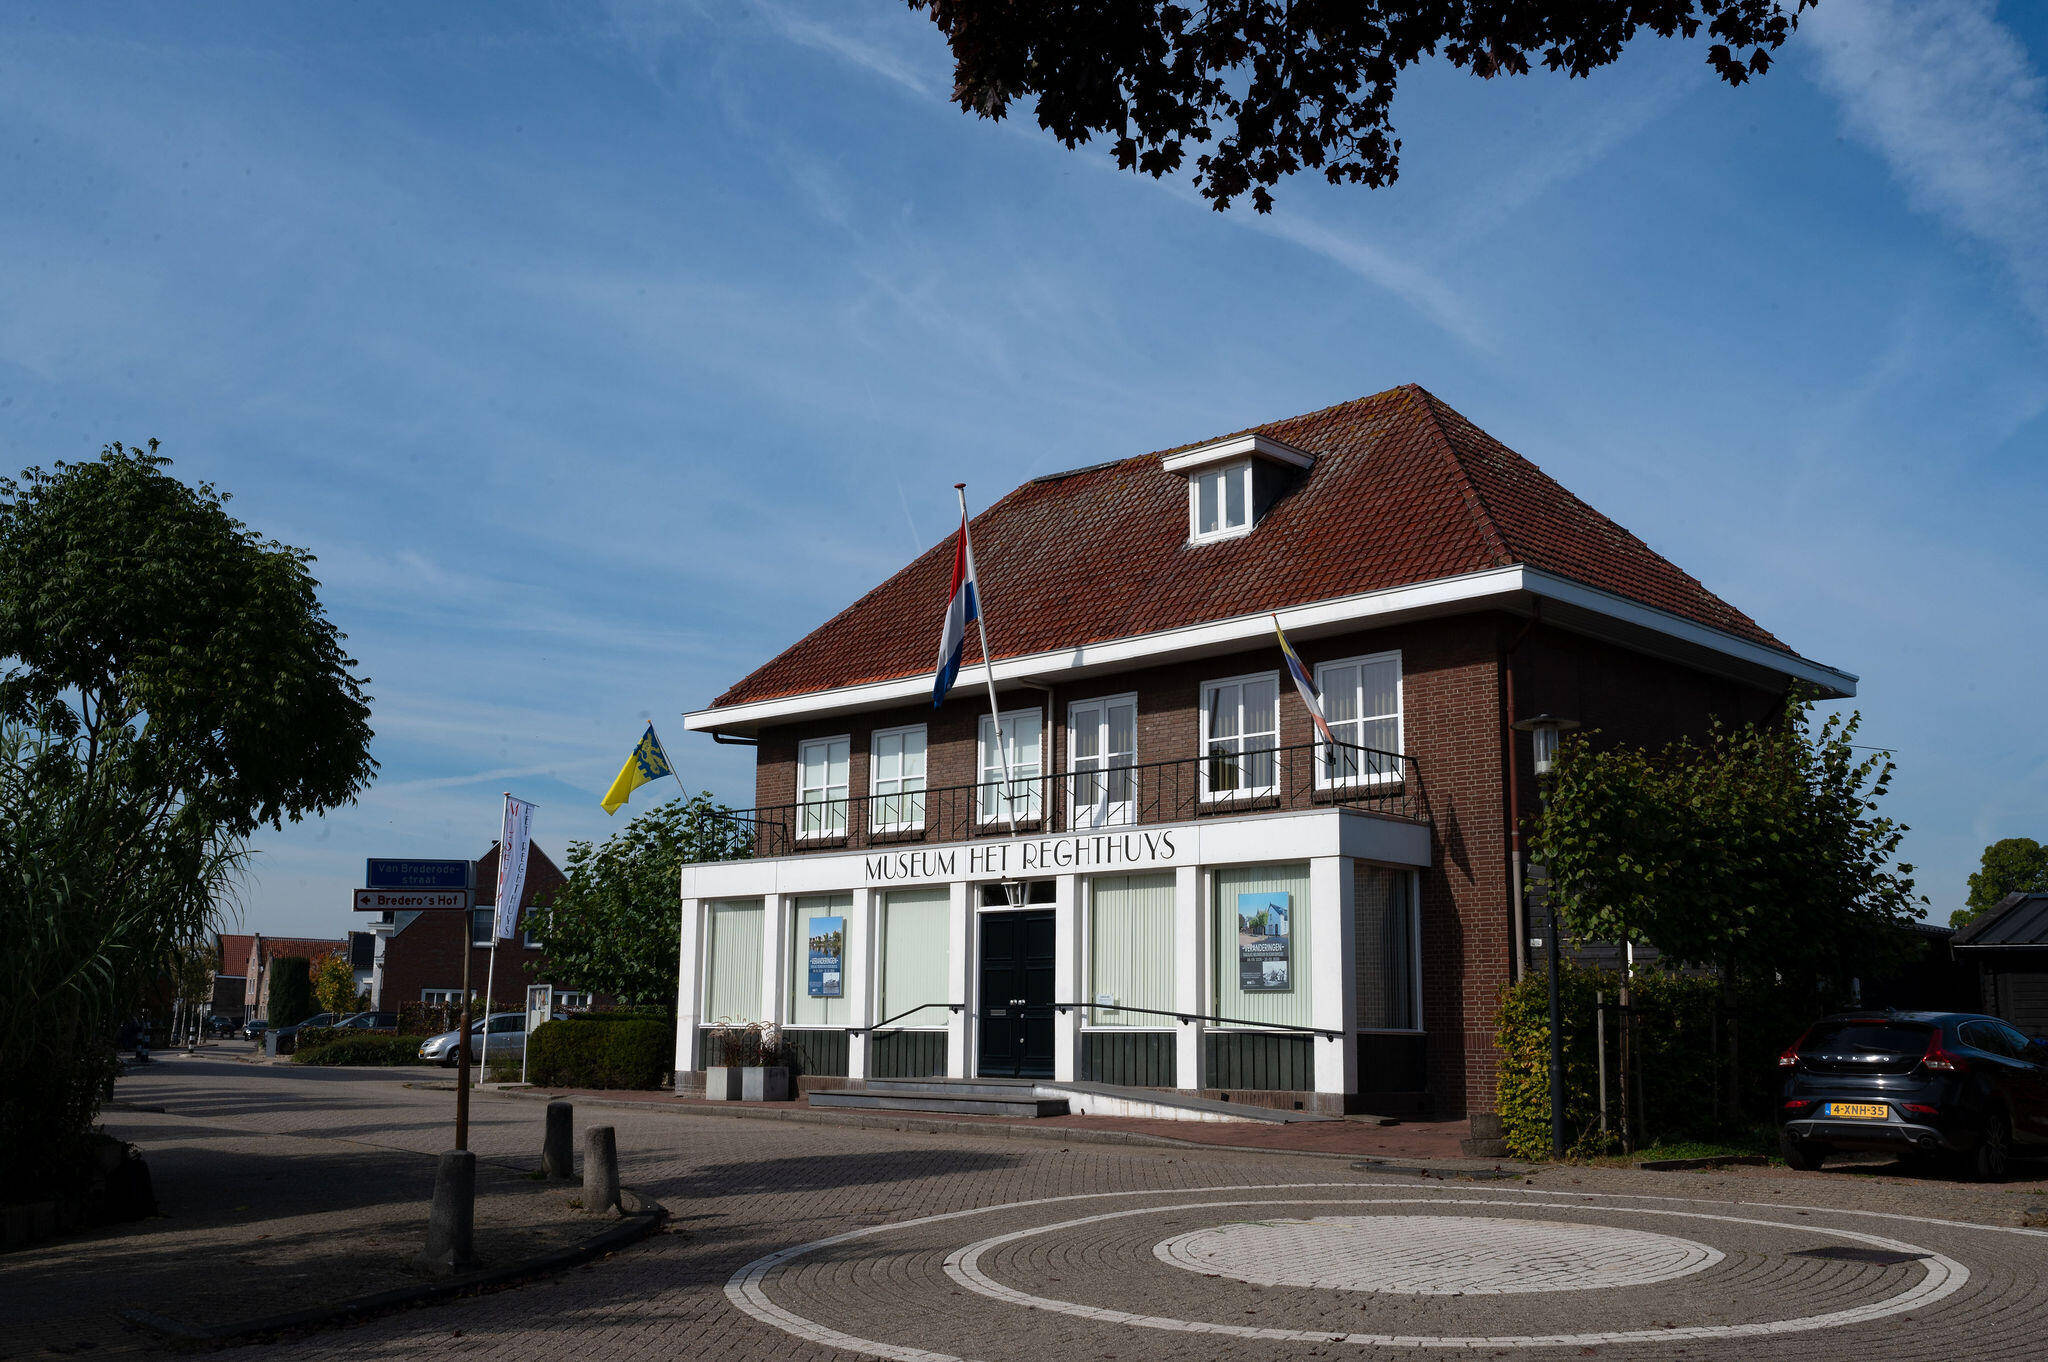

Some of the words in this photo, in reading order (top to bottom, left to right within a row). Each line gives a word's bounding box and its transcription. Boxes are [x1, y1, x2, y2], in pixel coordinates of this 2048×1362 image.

[865, 850, 955, 881] MUSEUM
[970, 844, 1011, 874] HET
[1022, 830, 1176, 870] REGHTHUYS
[378, 863, 398, 873] Van
[401, 863, 460, 874] Brederode-
[401, 875, 437, 884] straat
[437, 895, 458, 906] Hof
[1833, 1105, 1885, 1116] 4-XNH-35
